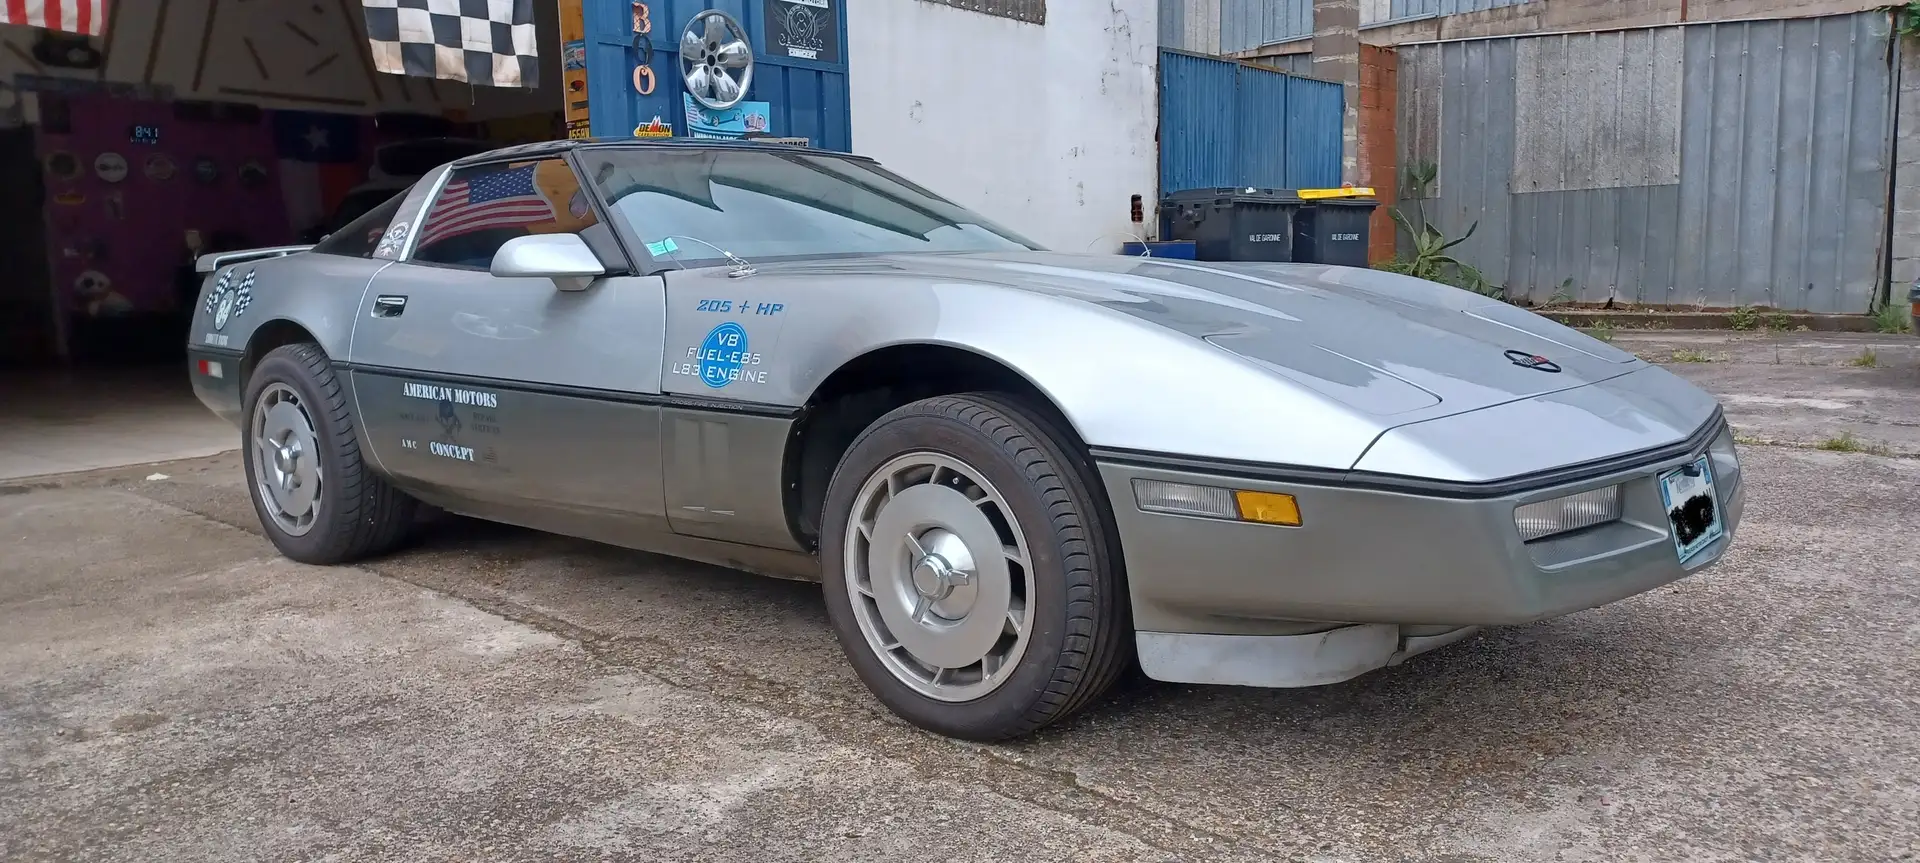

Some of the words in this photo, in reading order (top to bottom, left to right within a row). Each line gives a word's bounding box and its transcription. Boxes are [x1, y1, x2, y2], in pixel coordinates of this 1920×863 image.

[639, 119, 671, 133] DEMON
[697, 299, 732, 313] 205
[755, 302, 784, 316] HP
[717, 333, 740, 347] V8
[686, 347, 761, 365] FUEL-E85
[672, 362, 700, 376] L83
[706, 366, 768, 384] ENGINE
[403, 382, 452, 402] AMERICAN
[454, 388, 498, 408] MOTORS
[429, 441, 475, 462] CONCEPT
